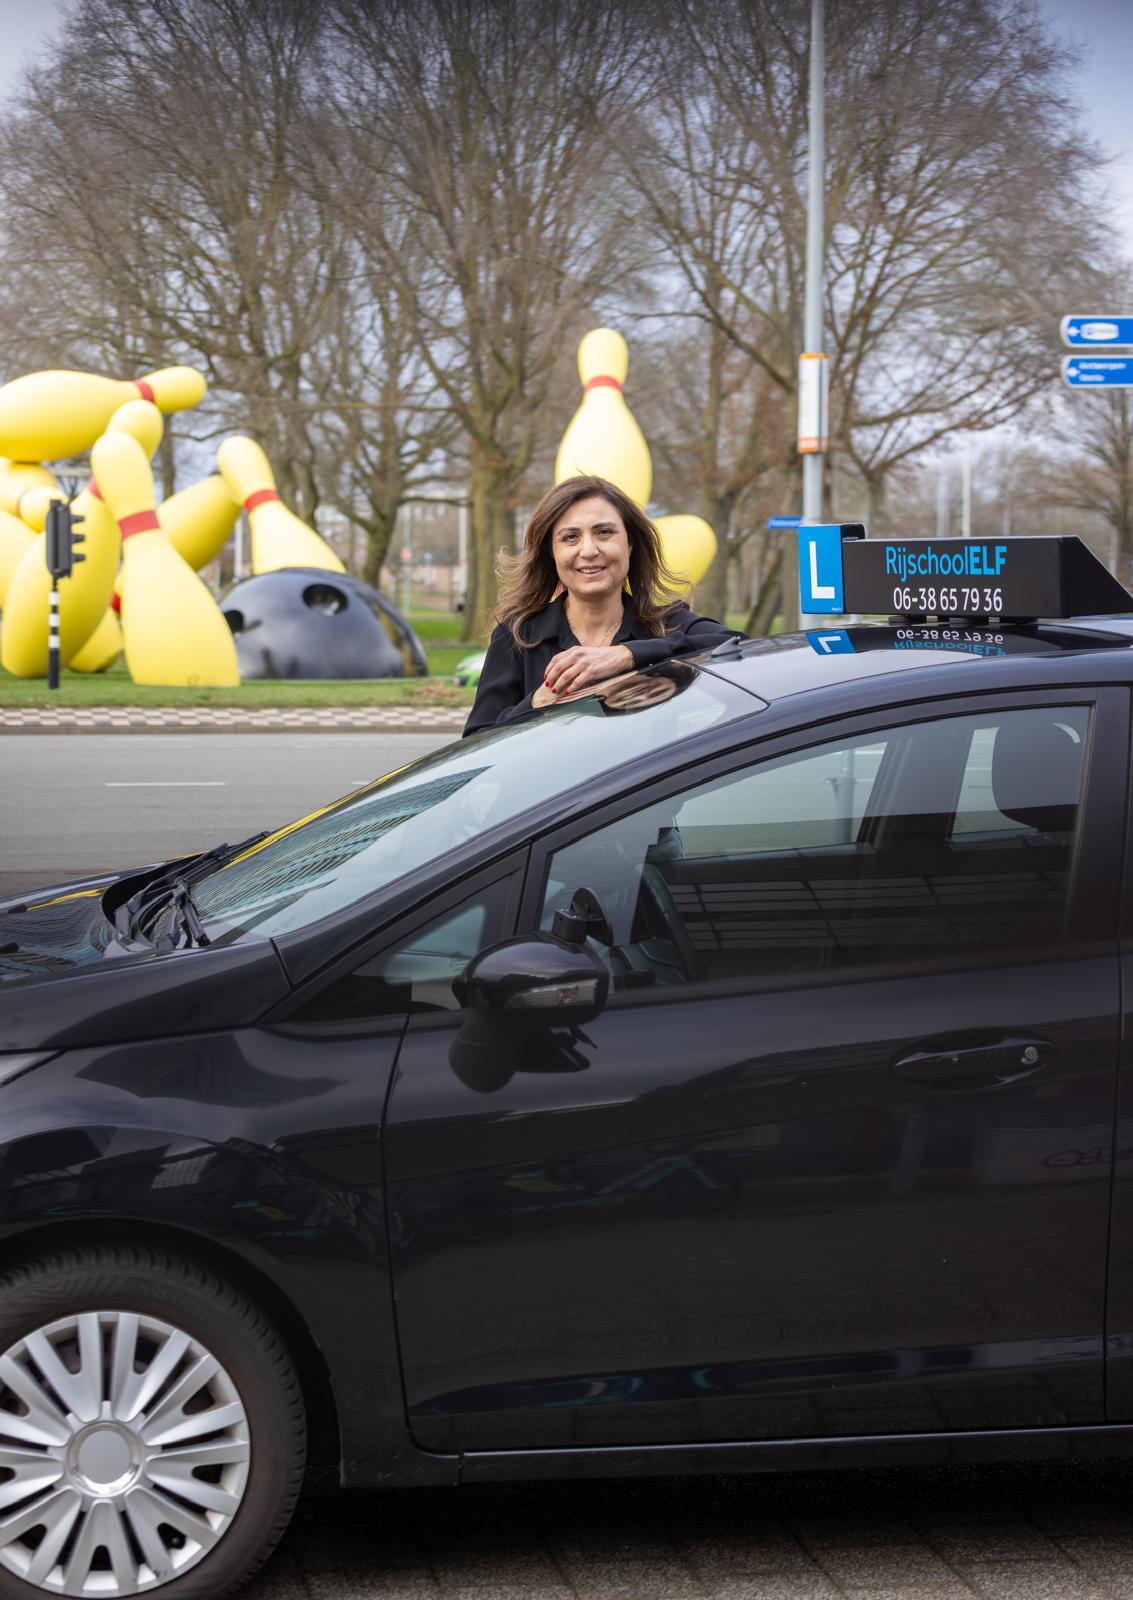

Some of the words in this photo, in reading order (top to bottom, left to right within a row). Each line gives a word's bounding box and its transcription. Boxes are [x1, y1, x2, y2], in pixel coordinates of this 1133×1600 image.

[808, 541, 836, 599] L
[885, 545, 1008, 582] RijschoolELF
[893, 587, 937, 611] 06-38
[940, 587, 958, 611] 65
[961, 587, 980, 611] 79
[983, 588, 1003, 612] 36
